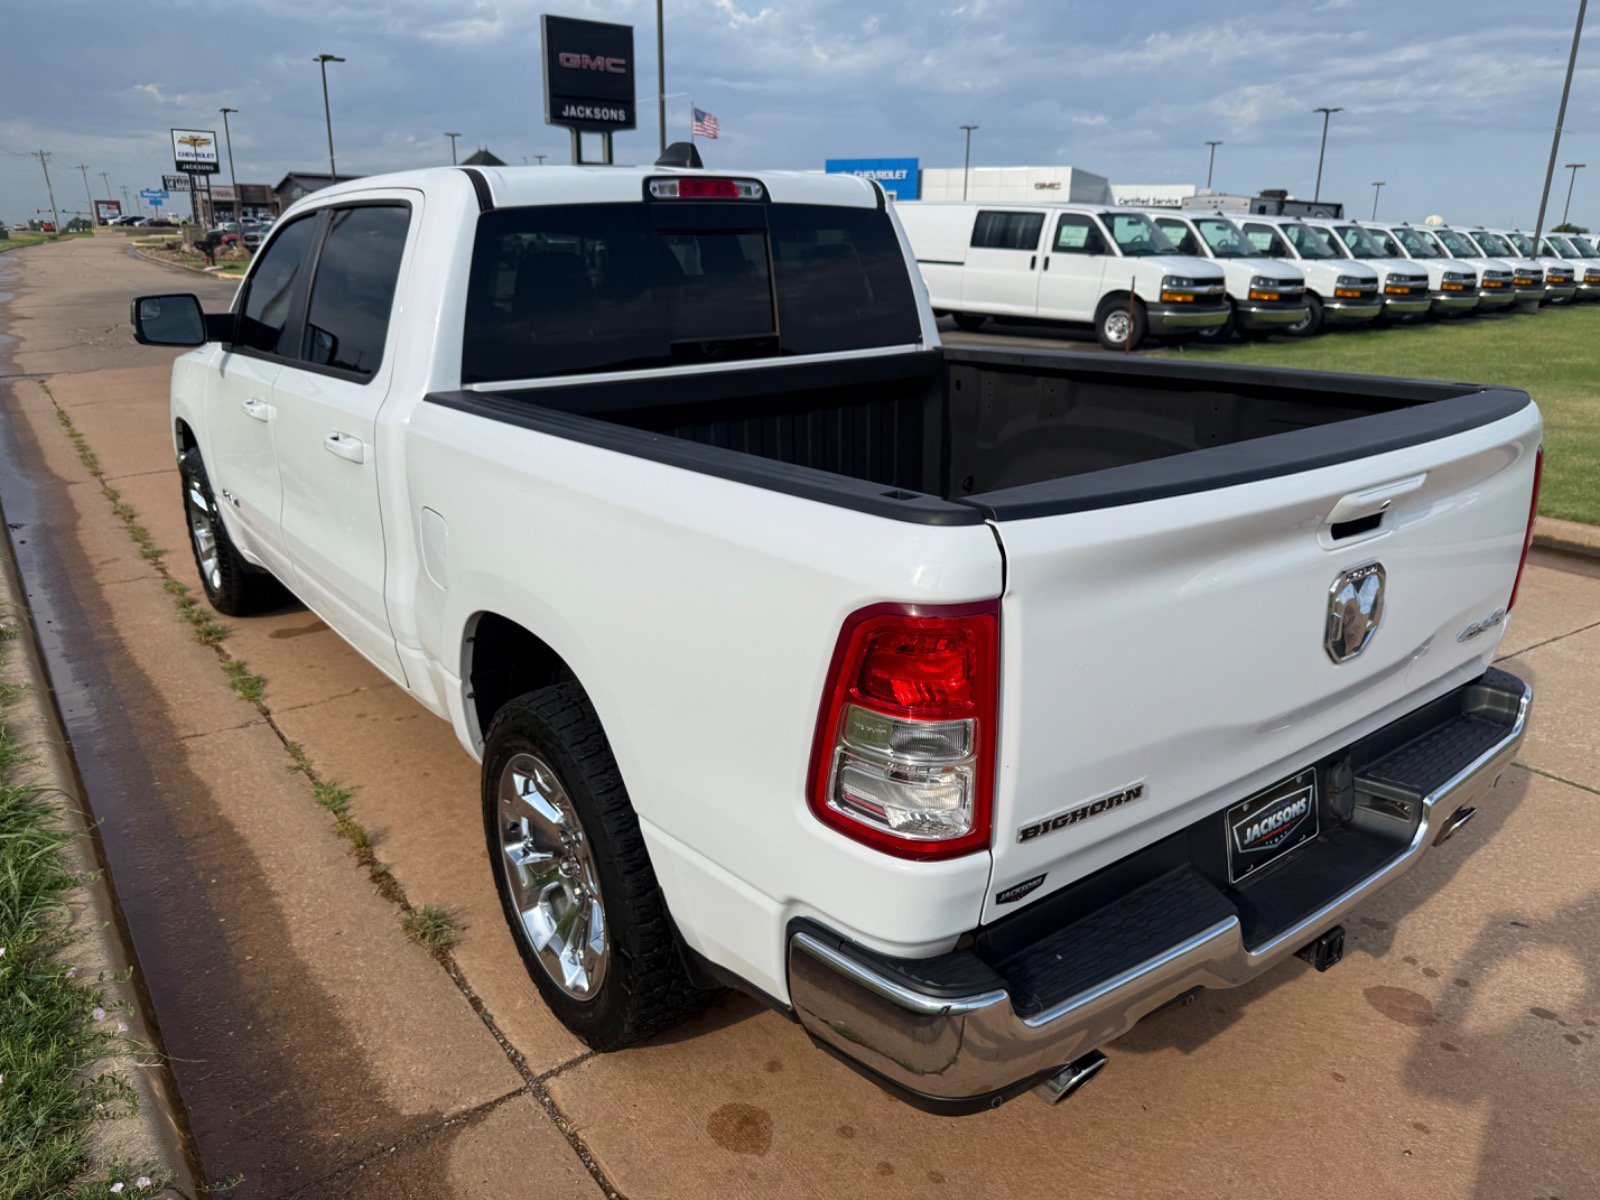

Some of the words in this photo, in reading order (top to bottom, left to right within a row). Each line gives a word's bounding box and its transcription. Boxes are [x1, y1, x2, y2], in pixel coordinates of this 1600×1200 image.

[559, 52, 626, 74] GMC
[562, 104, 626, 121] JACKSONS
[182, 163, 214, 171] JACKSONS
[1034, 182, 1061, 190] GMC
[1118, 197, 1150, 206] Certified
[1152, 197, 1179, 206] Service
[1243, 797, 1307, 845] JACKSONS
